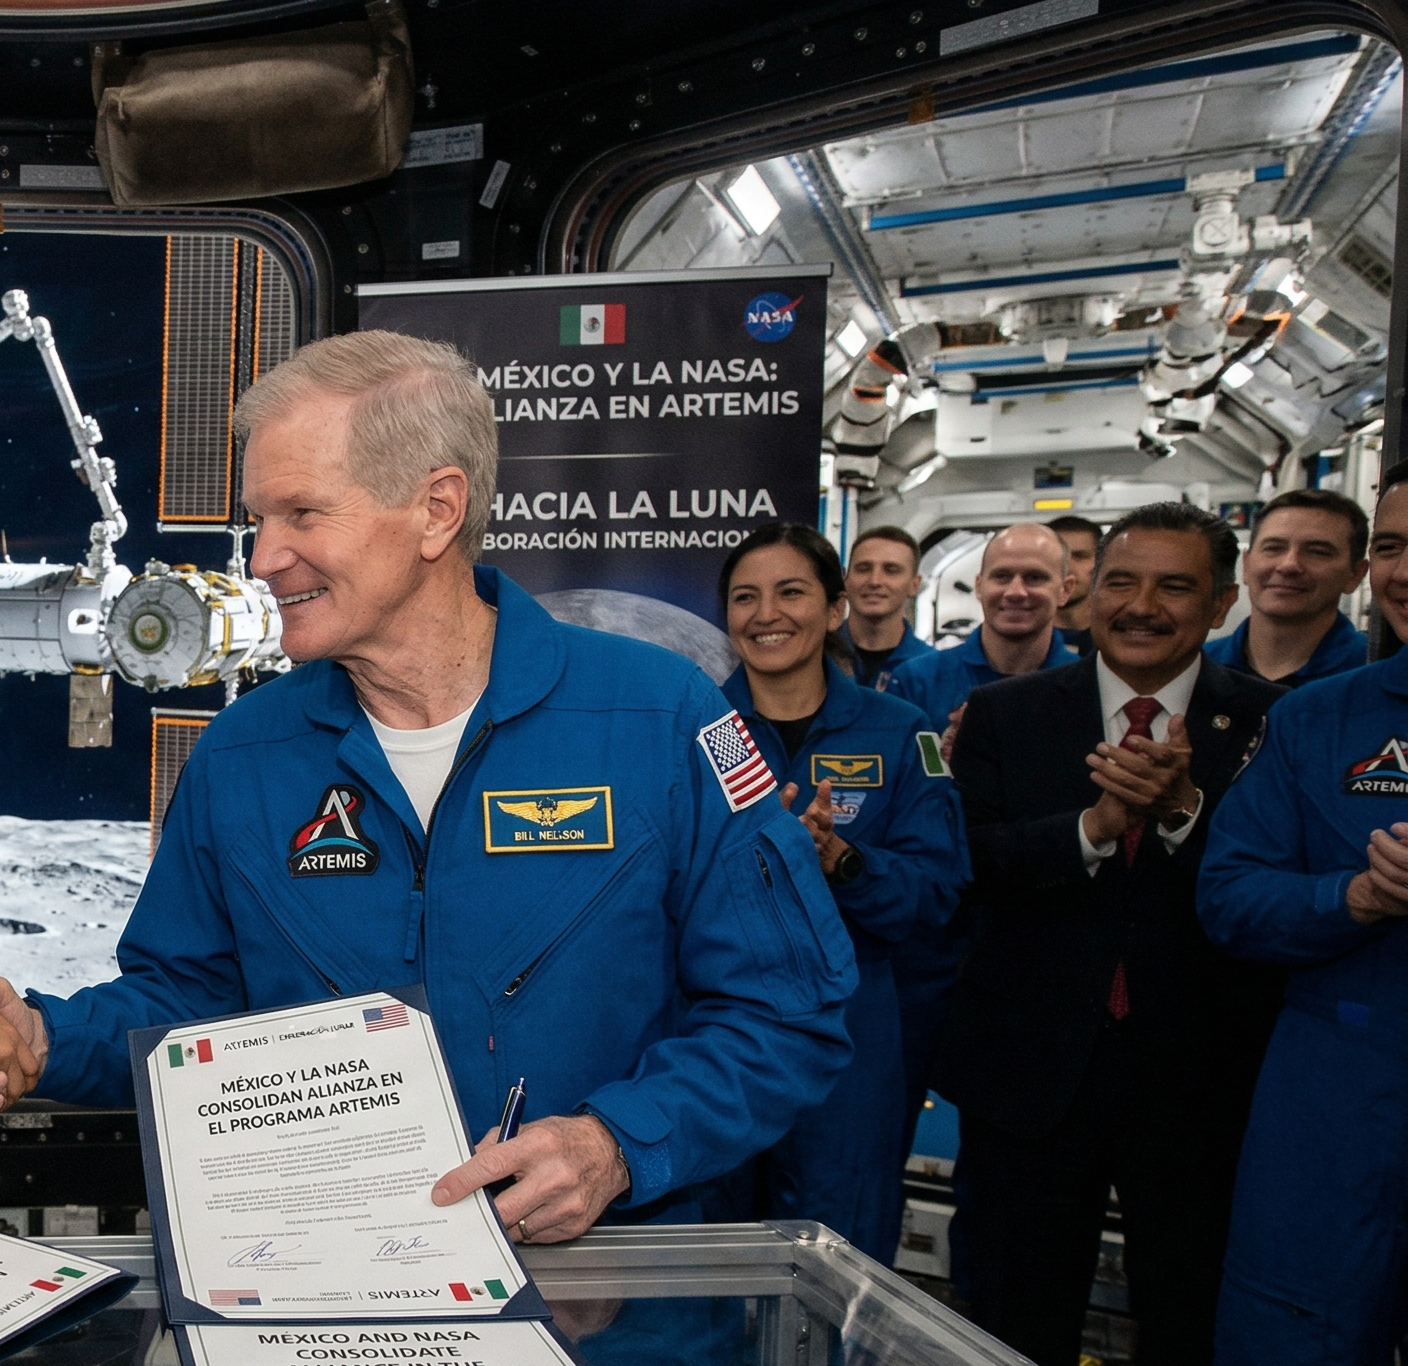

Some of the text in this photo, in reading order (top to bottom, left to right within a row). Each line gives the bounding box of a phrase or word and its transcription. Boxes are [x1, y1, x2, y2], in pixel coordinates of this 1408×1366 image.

[748, 310, 793, 323] NASA
[477, 358, 778, 389] MÉXICO Y LA NASA:
[492, 390, 800, 422] LIANZA EN ARTEMIS
[609, 490, 658, 520] LA
[669, 488, 778, 518] LUNA
[482, 528, 598, 550] BORACIÓN
[298, 853, 367, 870] ARTEMIS
[221, 1058, 370, 1095] MÉXICO Y LA NASA
[197, 1071, 404, 1117] CONSOLIDAN ALIANZA EN
[208, 1092, 401, 1135] EL PROGRAMA ARTEMIS
[368, 1289, 440, 1300] ARTEMIS
[258, 1331, 481, 1344] MÉXICO AND NASA
[296, 1346, 462, 1360] CONSOLIDATE
